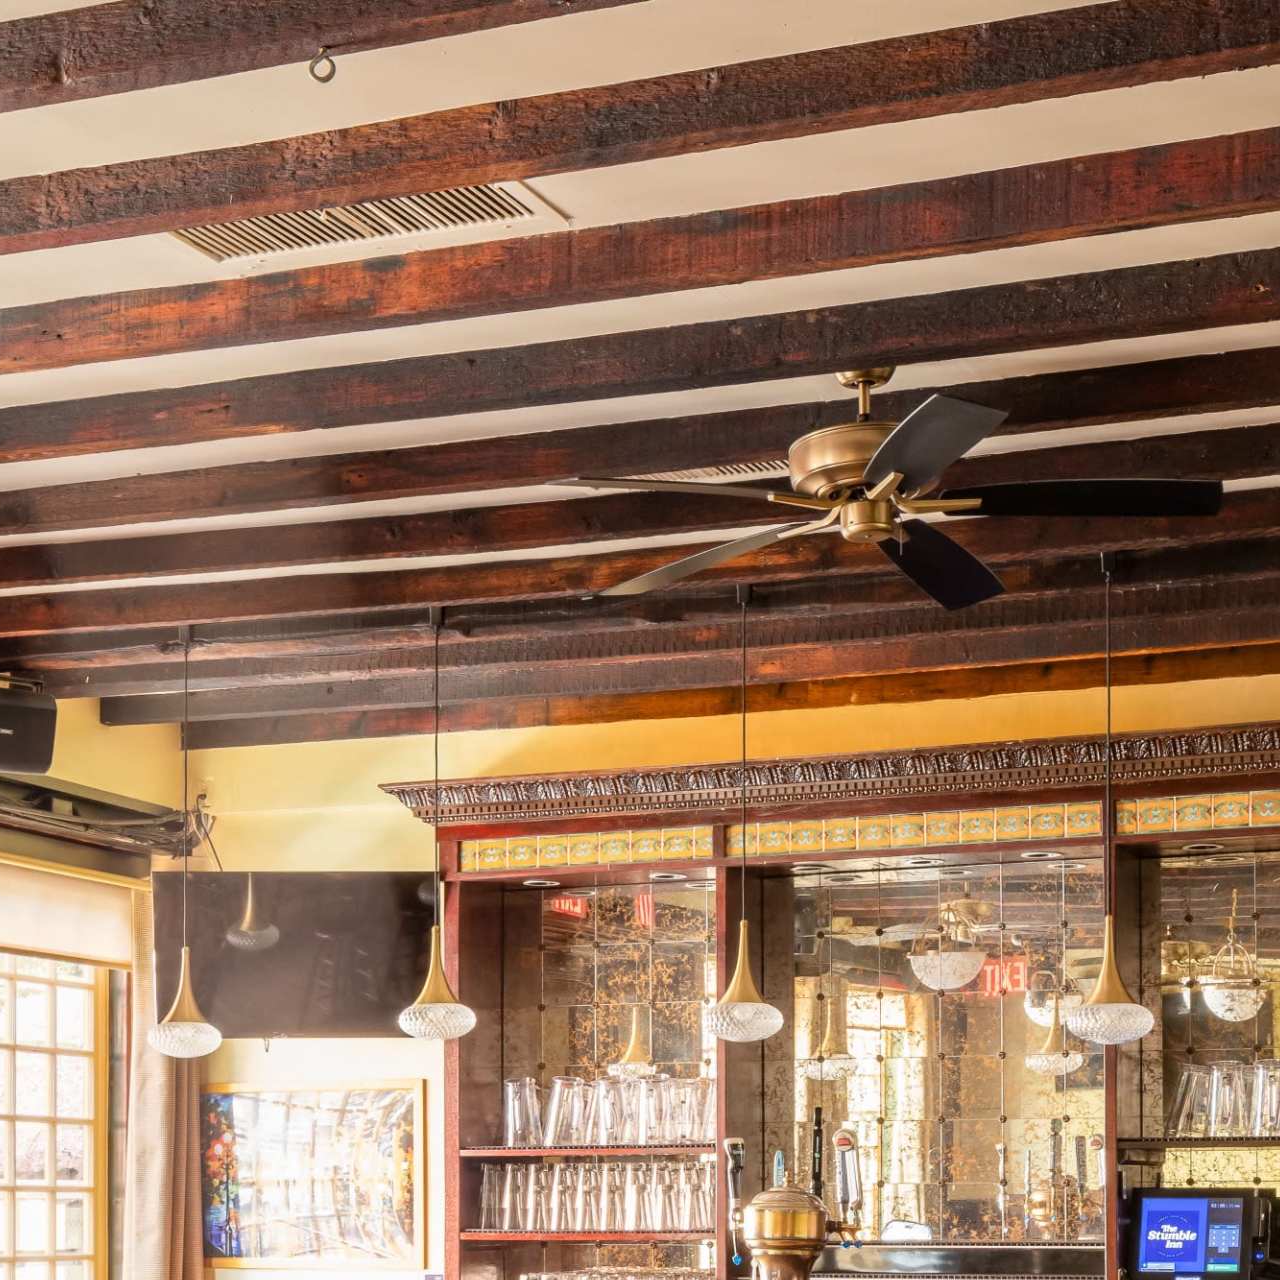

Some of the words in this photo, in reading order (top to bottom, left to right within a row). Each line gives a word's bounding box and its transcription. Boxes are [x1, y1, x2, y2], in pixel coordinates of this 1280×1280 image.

[1160, 1224, 1178, 1232] The
[1147, 1230, 1197, 1240] Stumble
[1165, 1239, 1183, 1249] Inn
